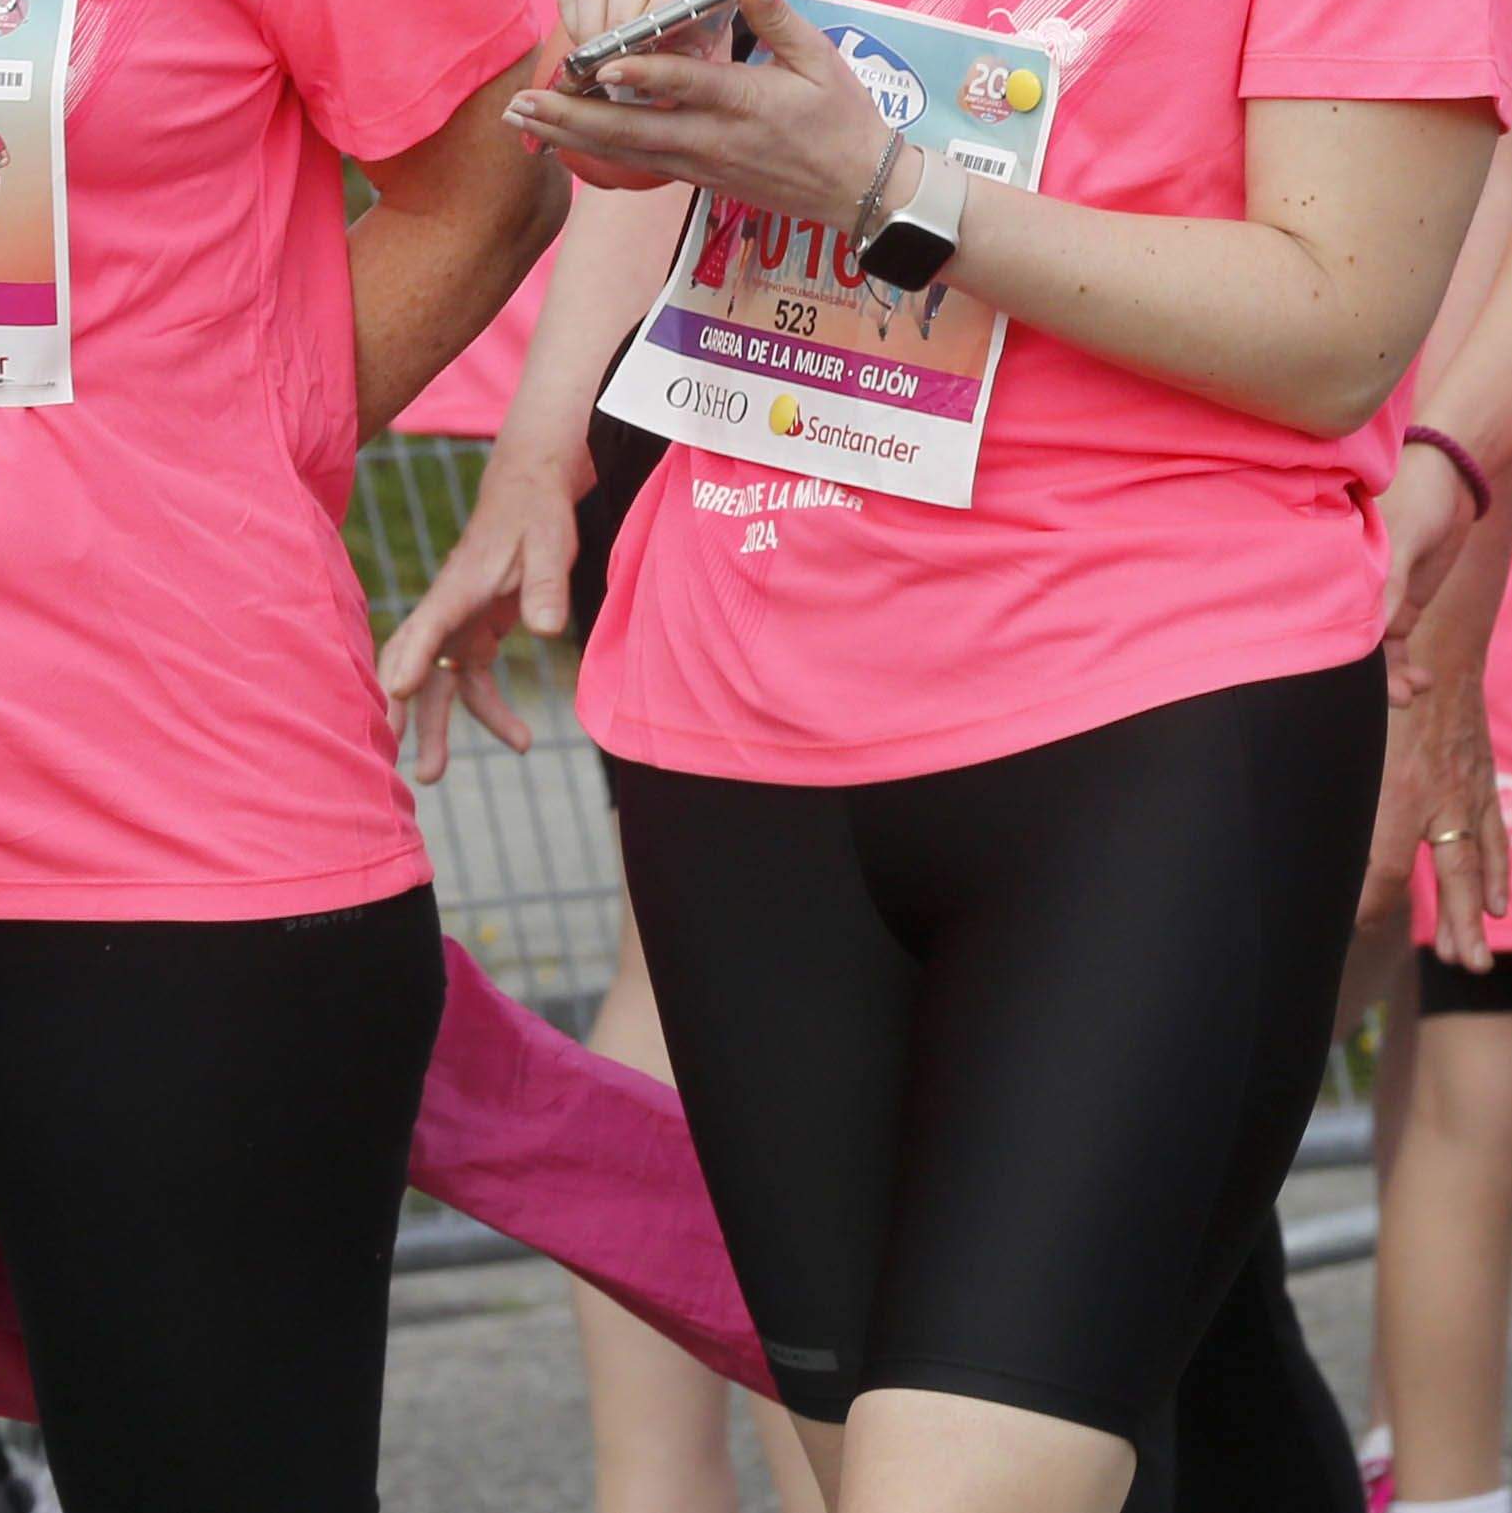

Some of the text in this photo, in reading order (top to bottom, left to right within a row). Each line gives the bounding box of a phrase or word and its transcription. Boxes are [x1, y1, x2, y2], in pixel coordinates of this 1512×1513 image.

[774, 298, 818, 337] 523
[699, 325, 920, 400] CARRERA DE LA MUJER GIJÓN
[666, 375, 921, 465] OYSHO Santander
[766, 480, 792, 511] LA
[792, 477, 864, 513] MUJER
